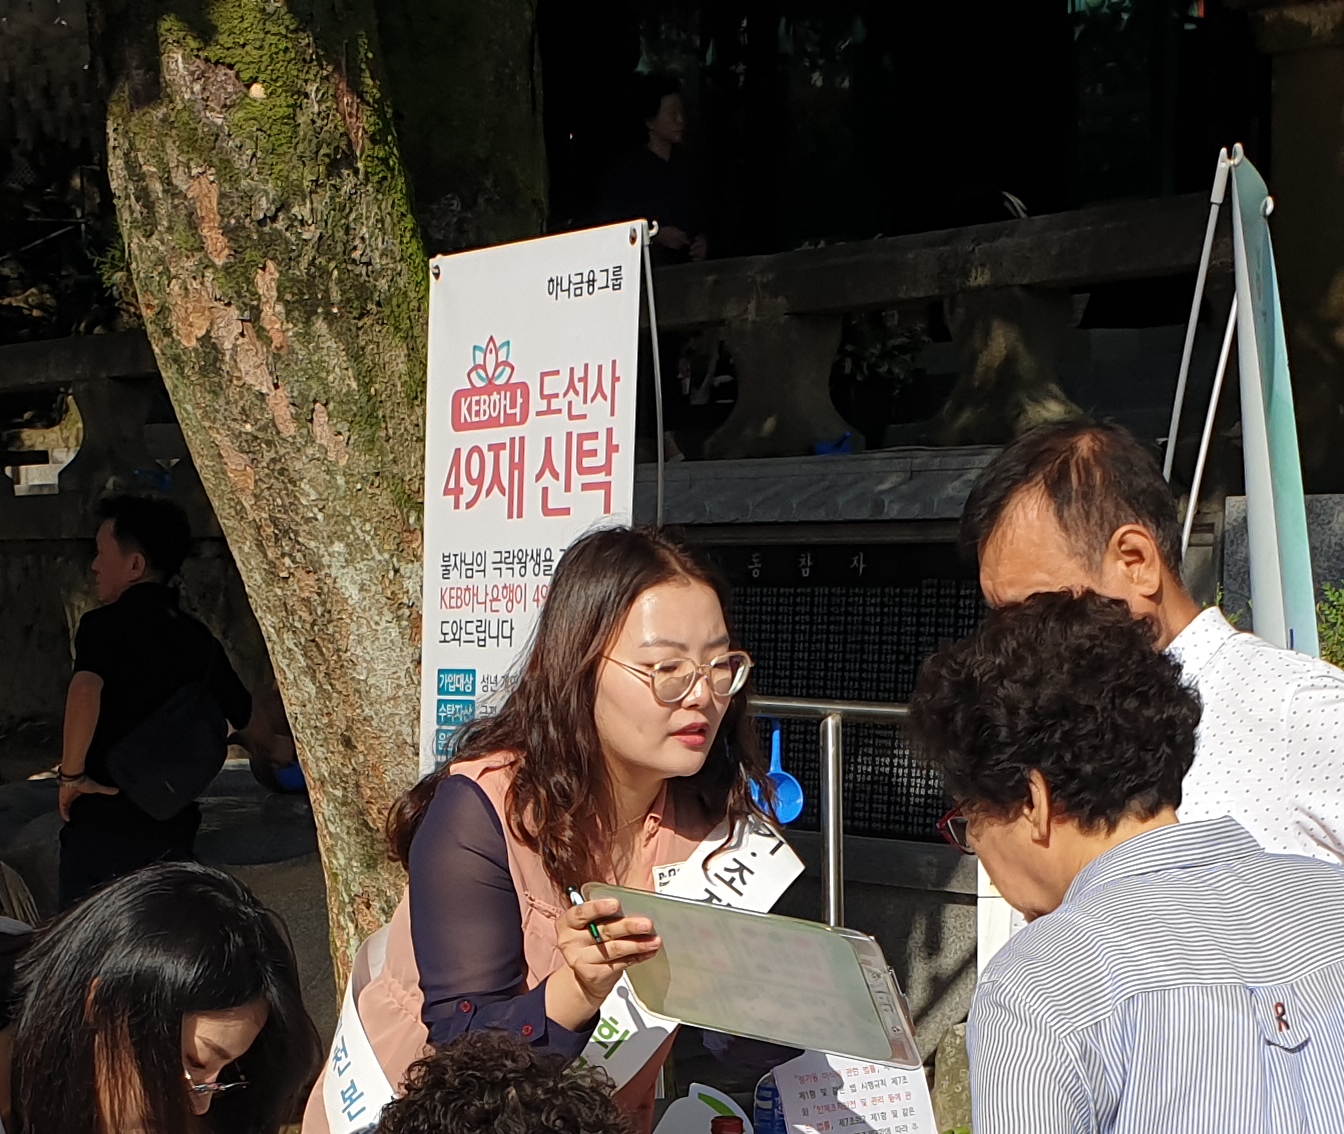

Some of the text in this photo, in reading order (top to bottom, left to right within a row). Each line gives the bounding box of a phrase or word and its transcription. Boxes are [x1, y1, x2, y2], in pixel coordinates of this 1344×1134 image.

[546, 264, 624, 300] 하나금융그룹
[459, 359, 621, 424] KEB하나 도선사
[443, 427, 620, 520] 49재 신탁
[440, 547, 555, 580] 불자님의 극락왕생을
[439, 582, 550, 614] KEB하나은행이 49
[438, 617, 515, 648] 도와드립니다
[439, 673, 474, 693] 가입대상
